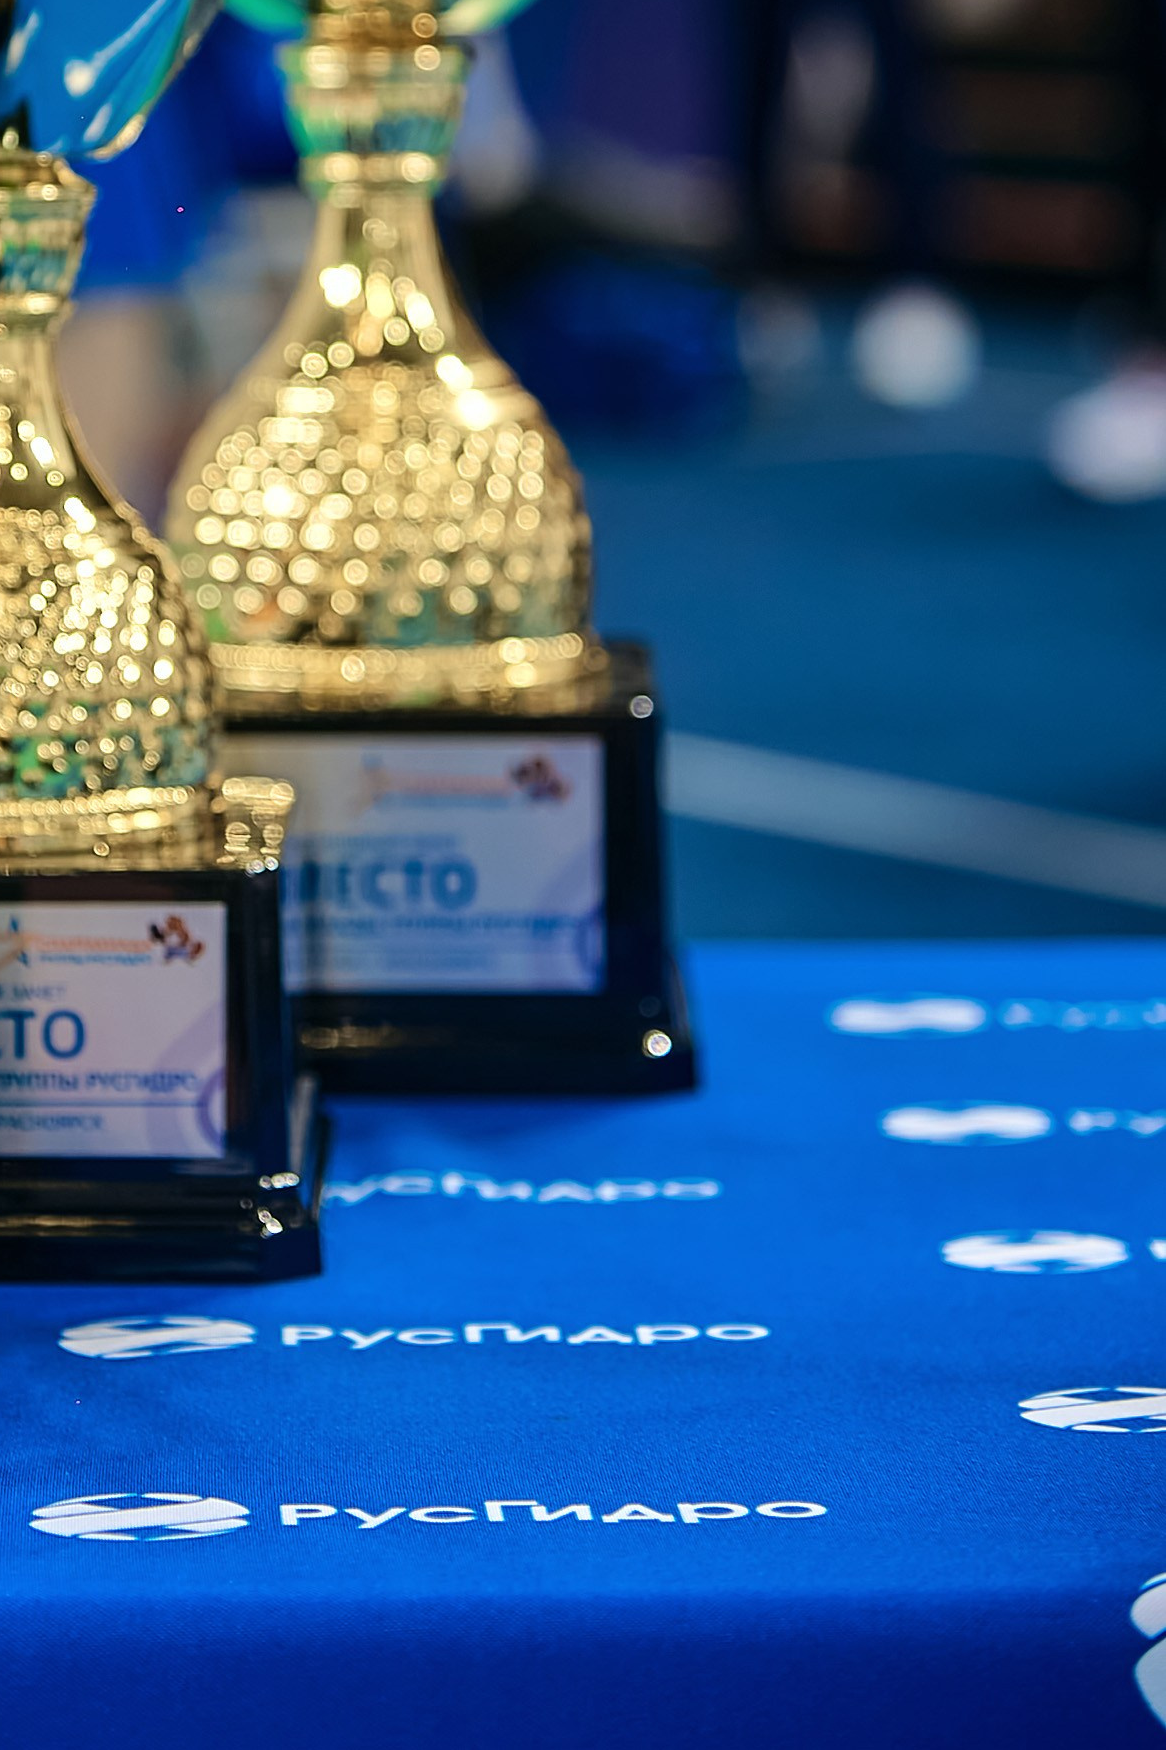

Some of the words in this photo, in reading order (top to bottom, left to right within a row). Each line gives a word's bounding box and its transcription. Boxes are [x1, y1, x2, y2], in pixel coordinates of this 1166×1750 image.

[322, 1169, 722, 1204] усГидро
[281, 1323, 770, 1349] РусГидро
[279, 1499, 828, 1529] РусГидро
